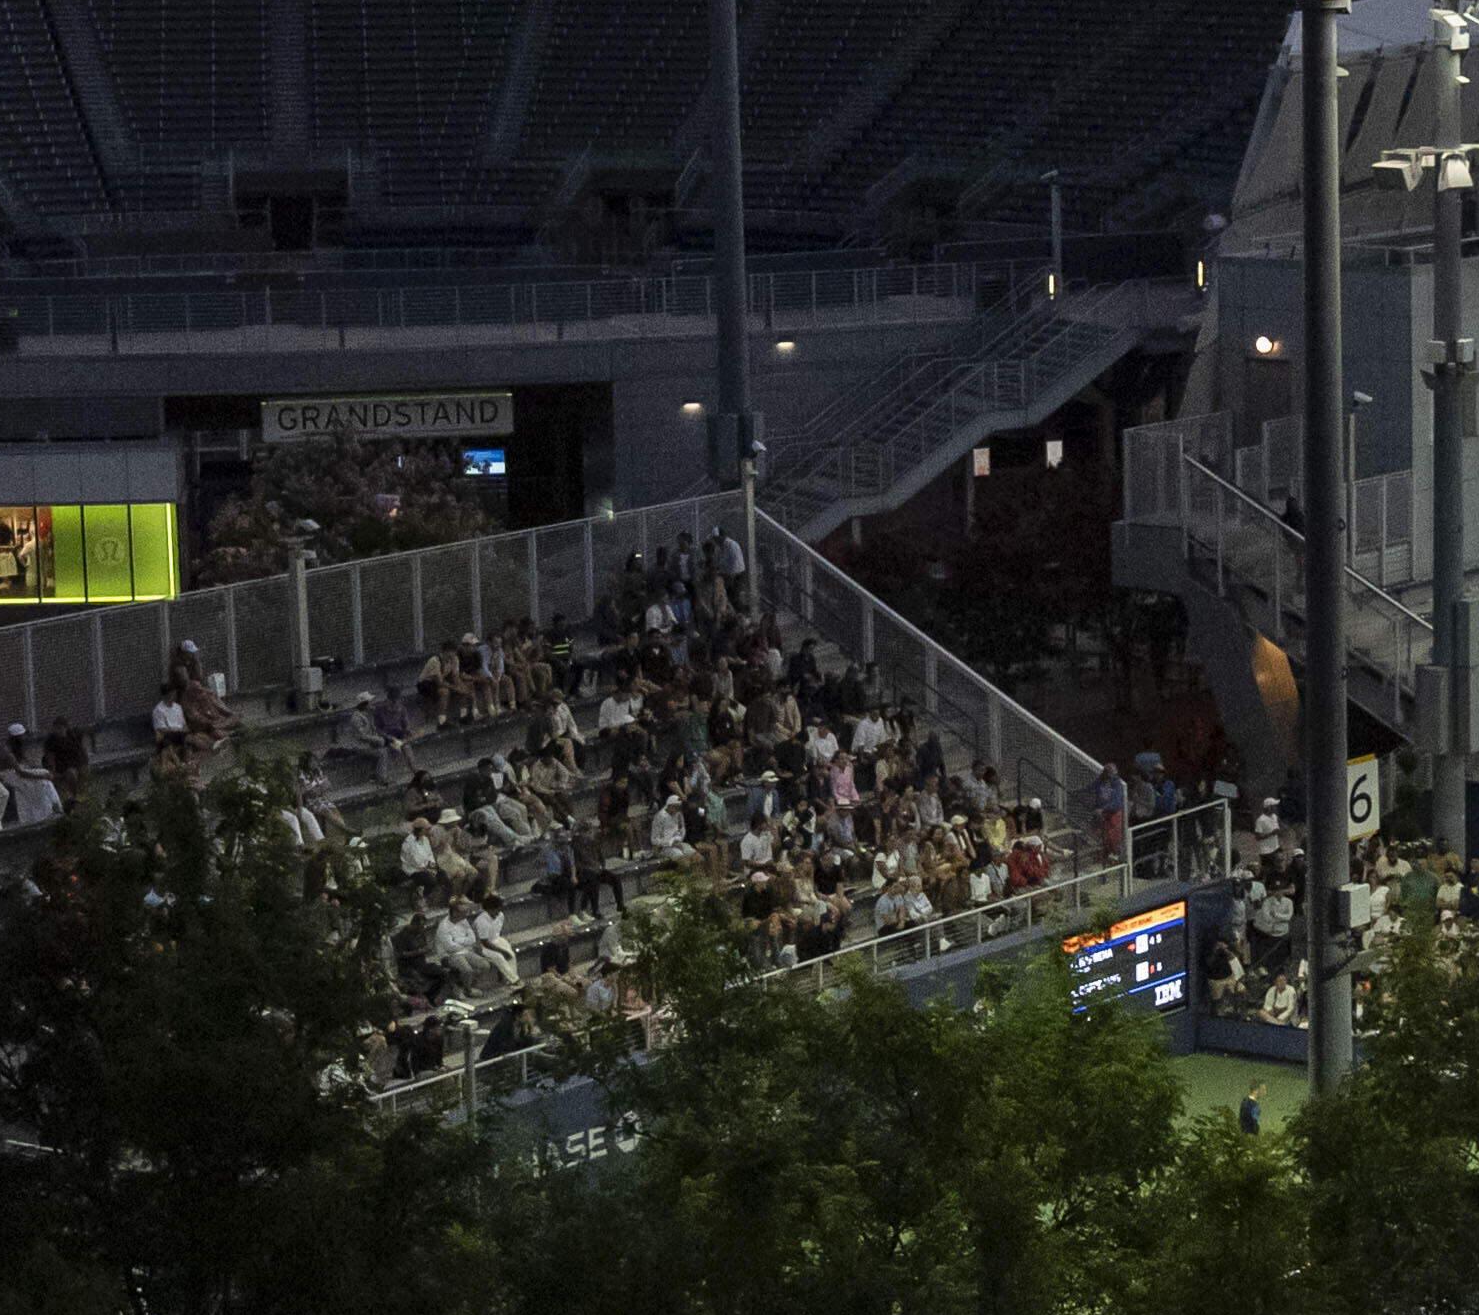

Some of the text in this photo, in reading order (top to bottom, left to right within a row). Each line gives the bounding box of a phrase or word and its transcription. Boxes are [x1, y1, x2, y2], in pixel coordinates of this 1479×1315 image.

[277, 399, 499, 431] GRANDSTAND
[1349, 772, 1372, 824] 6
[1154, 979, 1183, 1006] IBM
